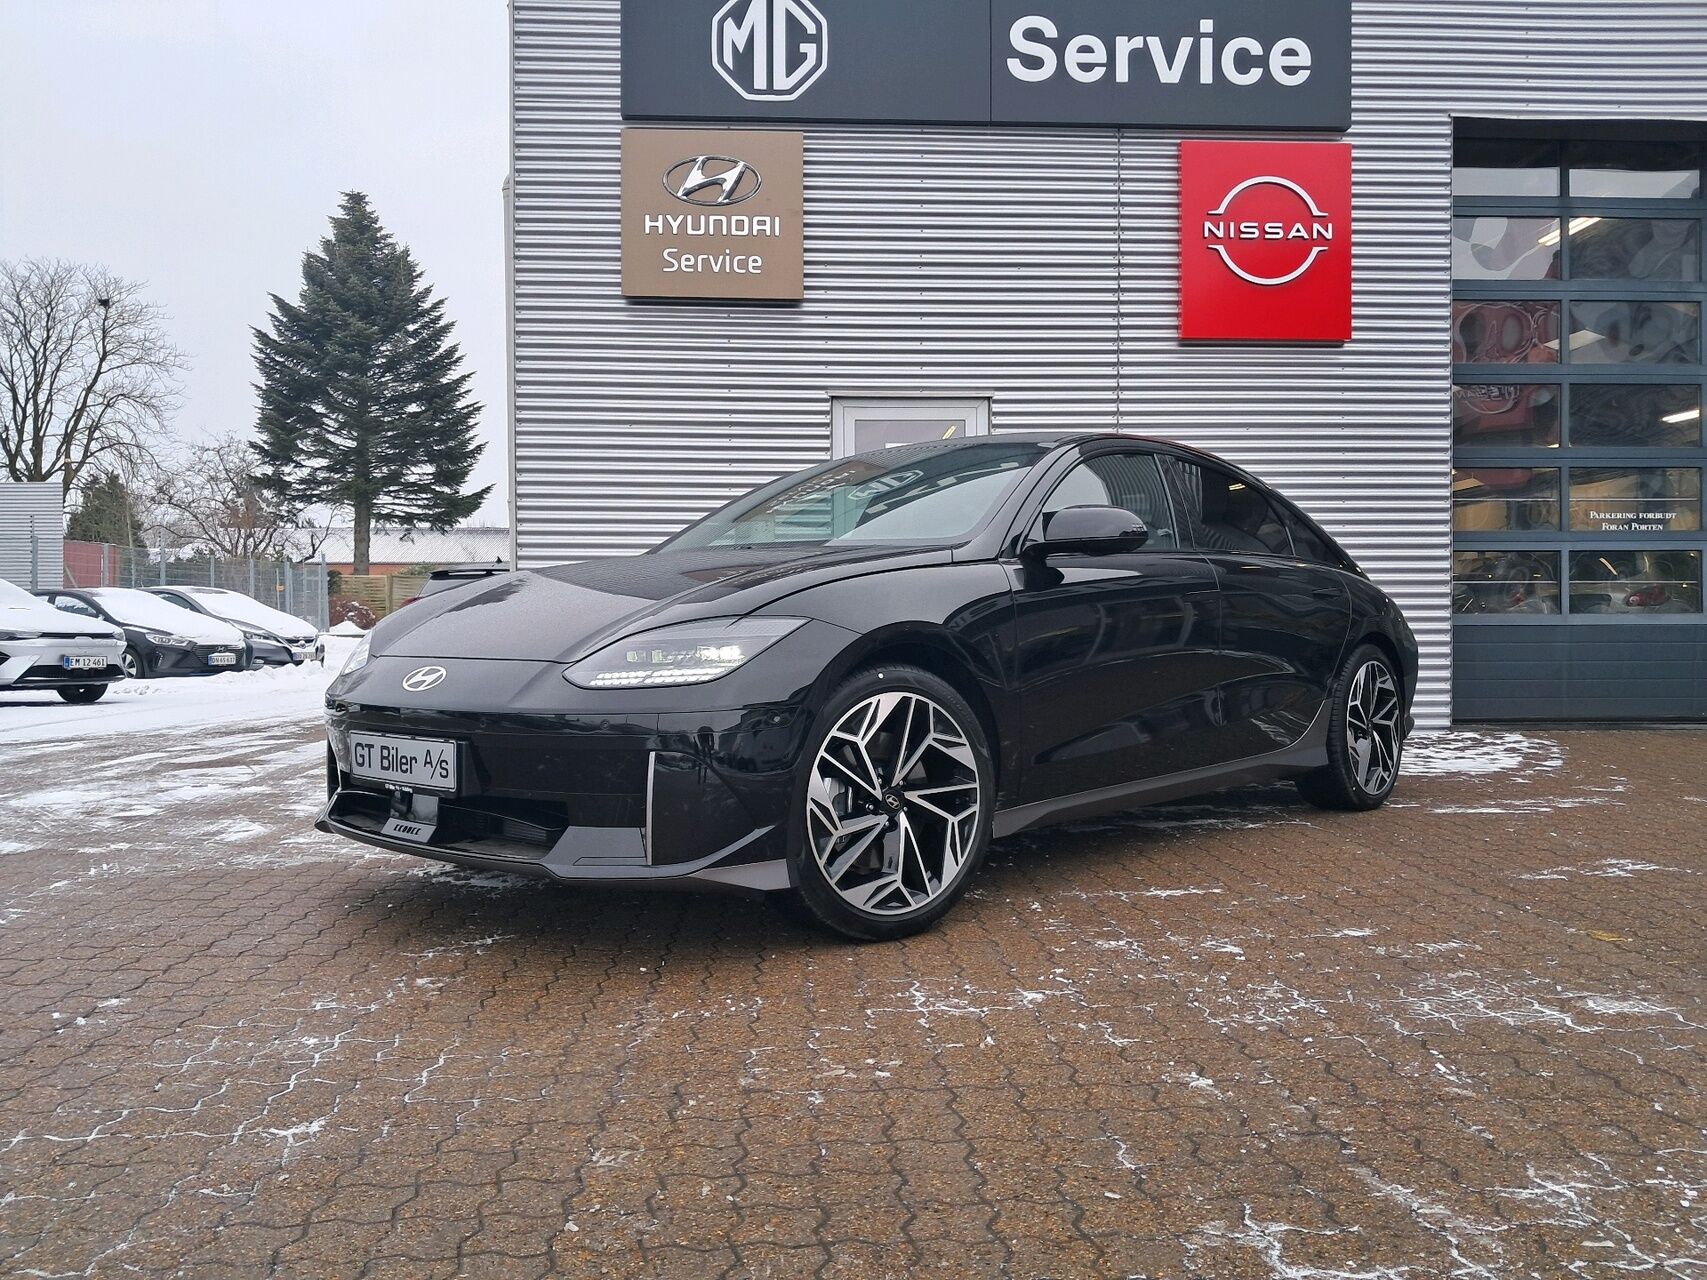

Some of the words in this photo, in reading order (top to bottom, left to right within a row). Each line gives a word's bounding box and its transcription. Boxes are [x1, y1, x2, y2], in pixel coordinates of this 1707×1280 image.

[723, 0, 817, 90] MG
[1006, 15, 1312, 86] Service
[644, 214, 780, 236] HYUNDAI
[1203, 221, 1333, 239] NISSAN
[662, 248, 762, 273] Service
[1590, 511, 1636, 519] PARKERING
[1602, 522, 1629, 531] FORAN
[1631, 522, 1663, 531] PORTEN
[83, 658, 91, 667] 12
[92, 658, 105, 667] 461
[354, 742, 374, 768] GT
[380, 745, 418, 775] Biler
[423, 748, 449, 780] A/S
